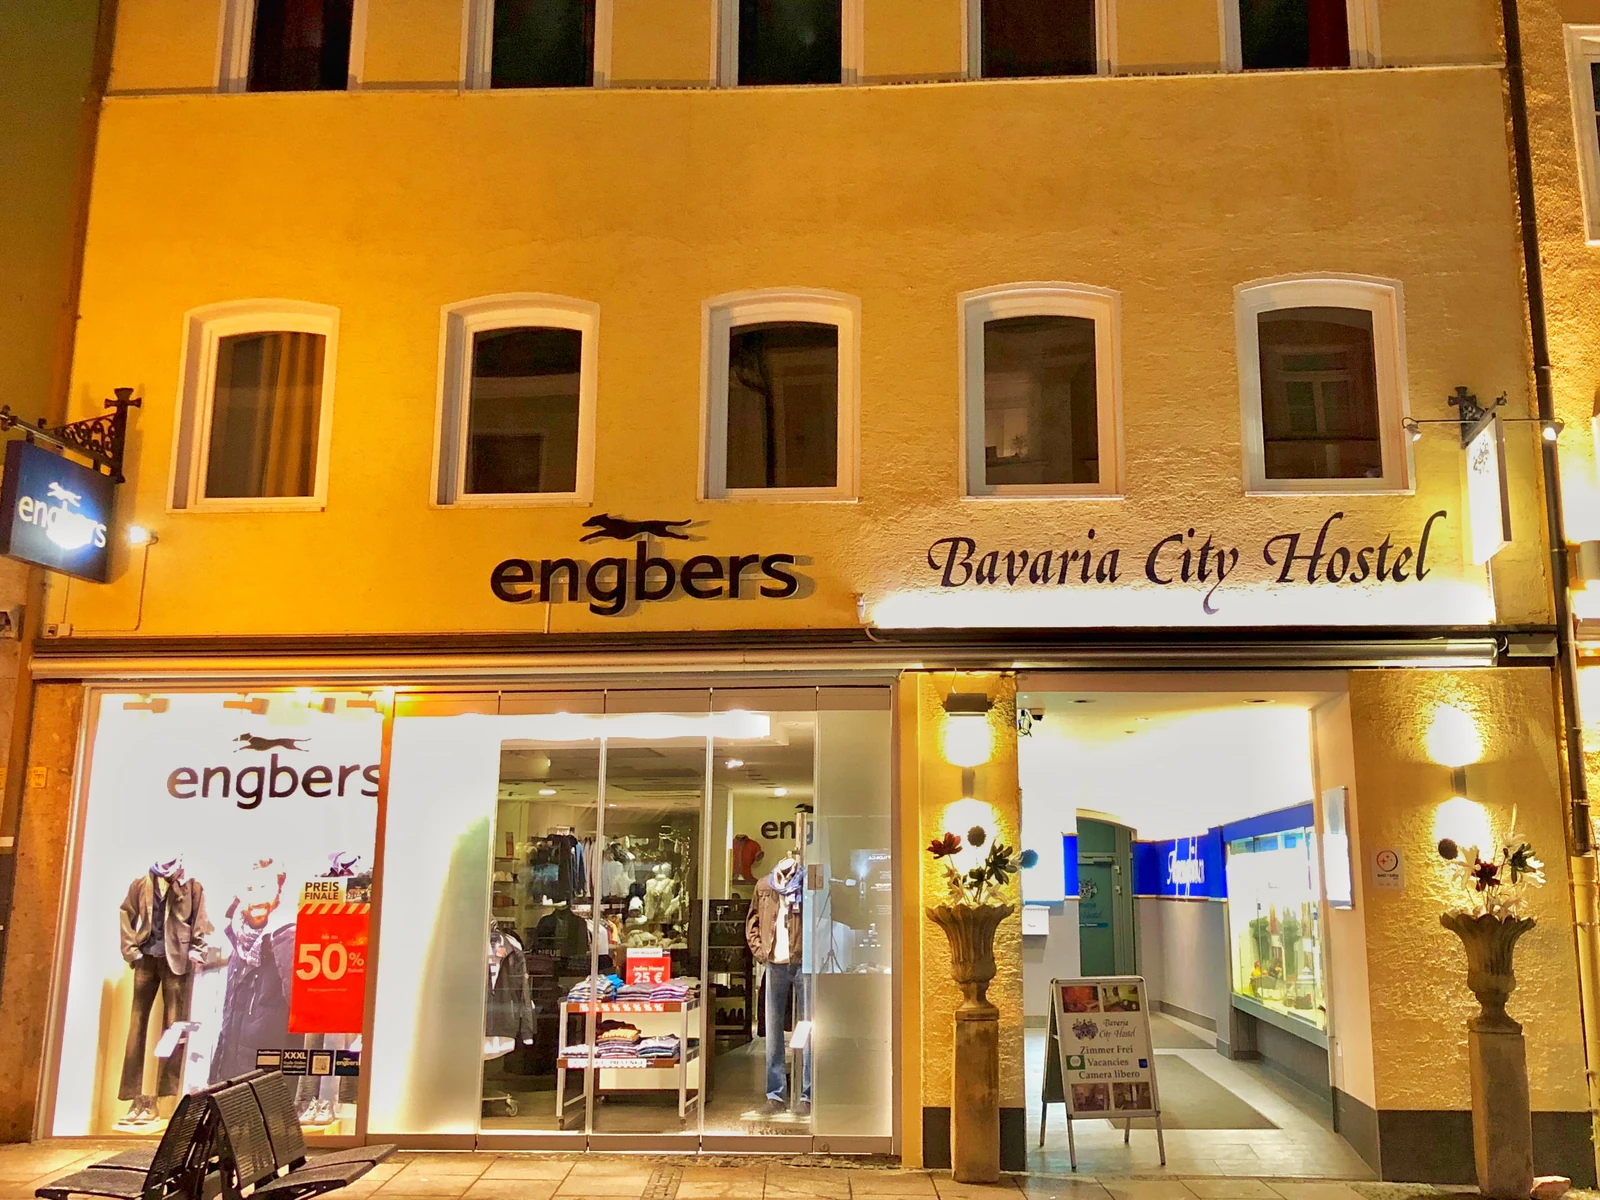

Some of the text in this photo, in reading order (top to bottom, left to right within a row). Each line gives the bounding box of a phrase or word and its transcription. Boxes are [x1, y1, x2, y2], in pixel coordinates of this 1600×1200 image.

[18, 495, 107, 548] engs
[927, 510, 1448, 615] Bavaria City Hostel
[490, 540, 798, 616] engbers
[167, 753, 379, 810] engbers
[305, 881, 339, 892] PREIS
[304, 892, 339, 900] FINALE
[634, 972, 650, 983] 25
[1103, 1019, 1129, 1027] Bavaria
[1080, 1046, 1134, 1054] Zimmer Frei
[284, 1051, 307, 1060] XXXL
[1087, 1058, 1129, 1067] Vacancies
[1079, 1070, 1141, 1079] Camera libero
